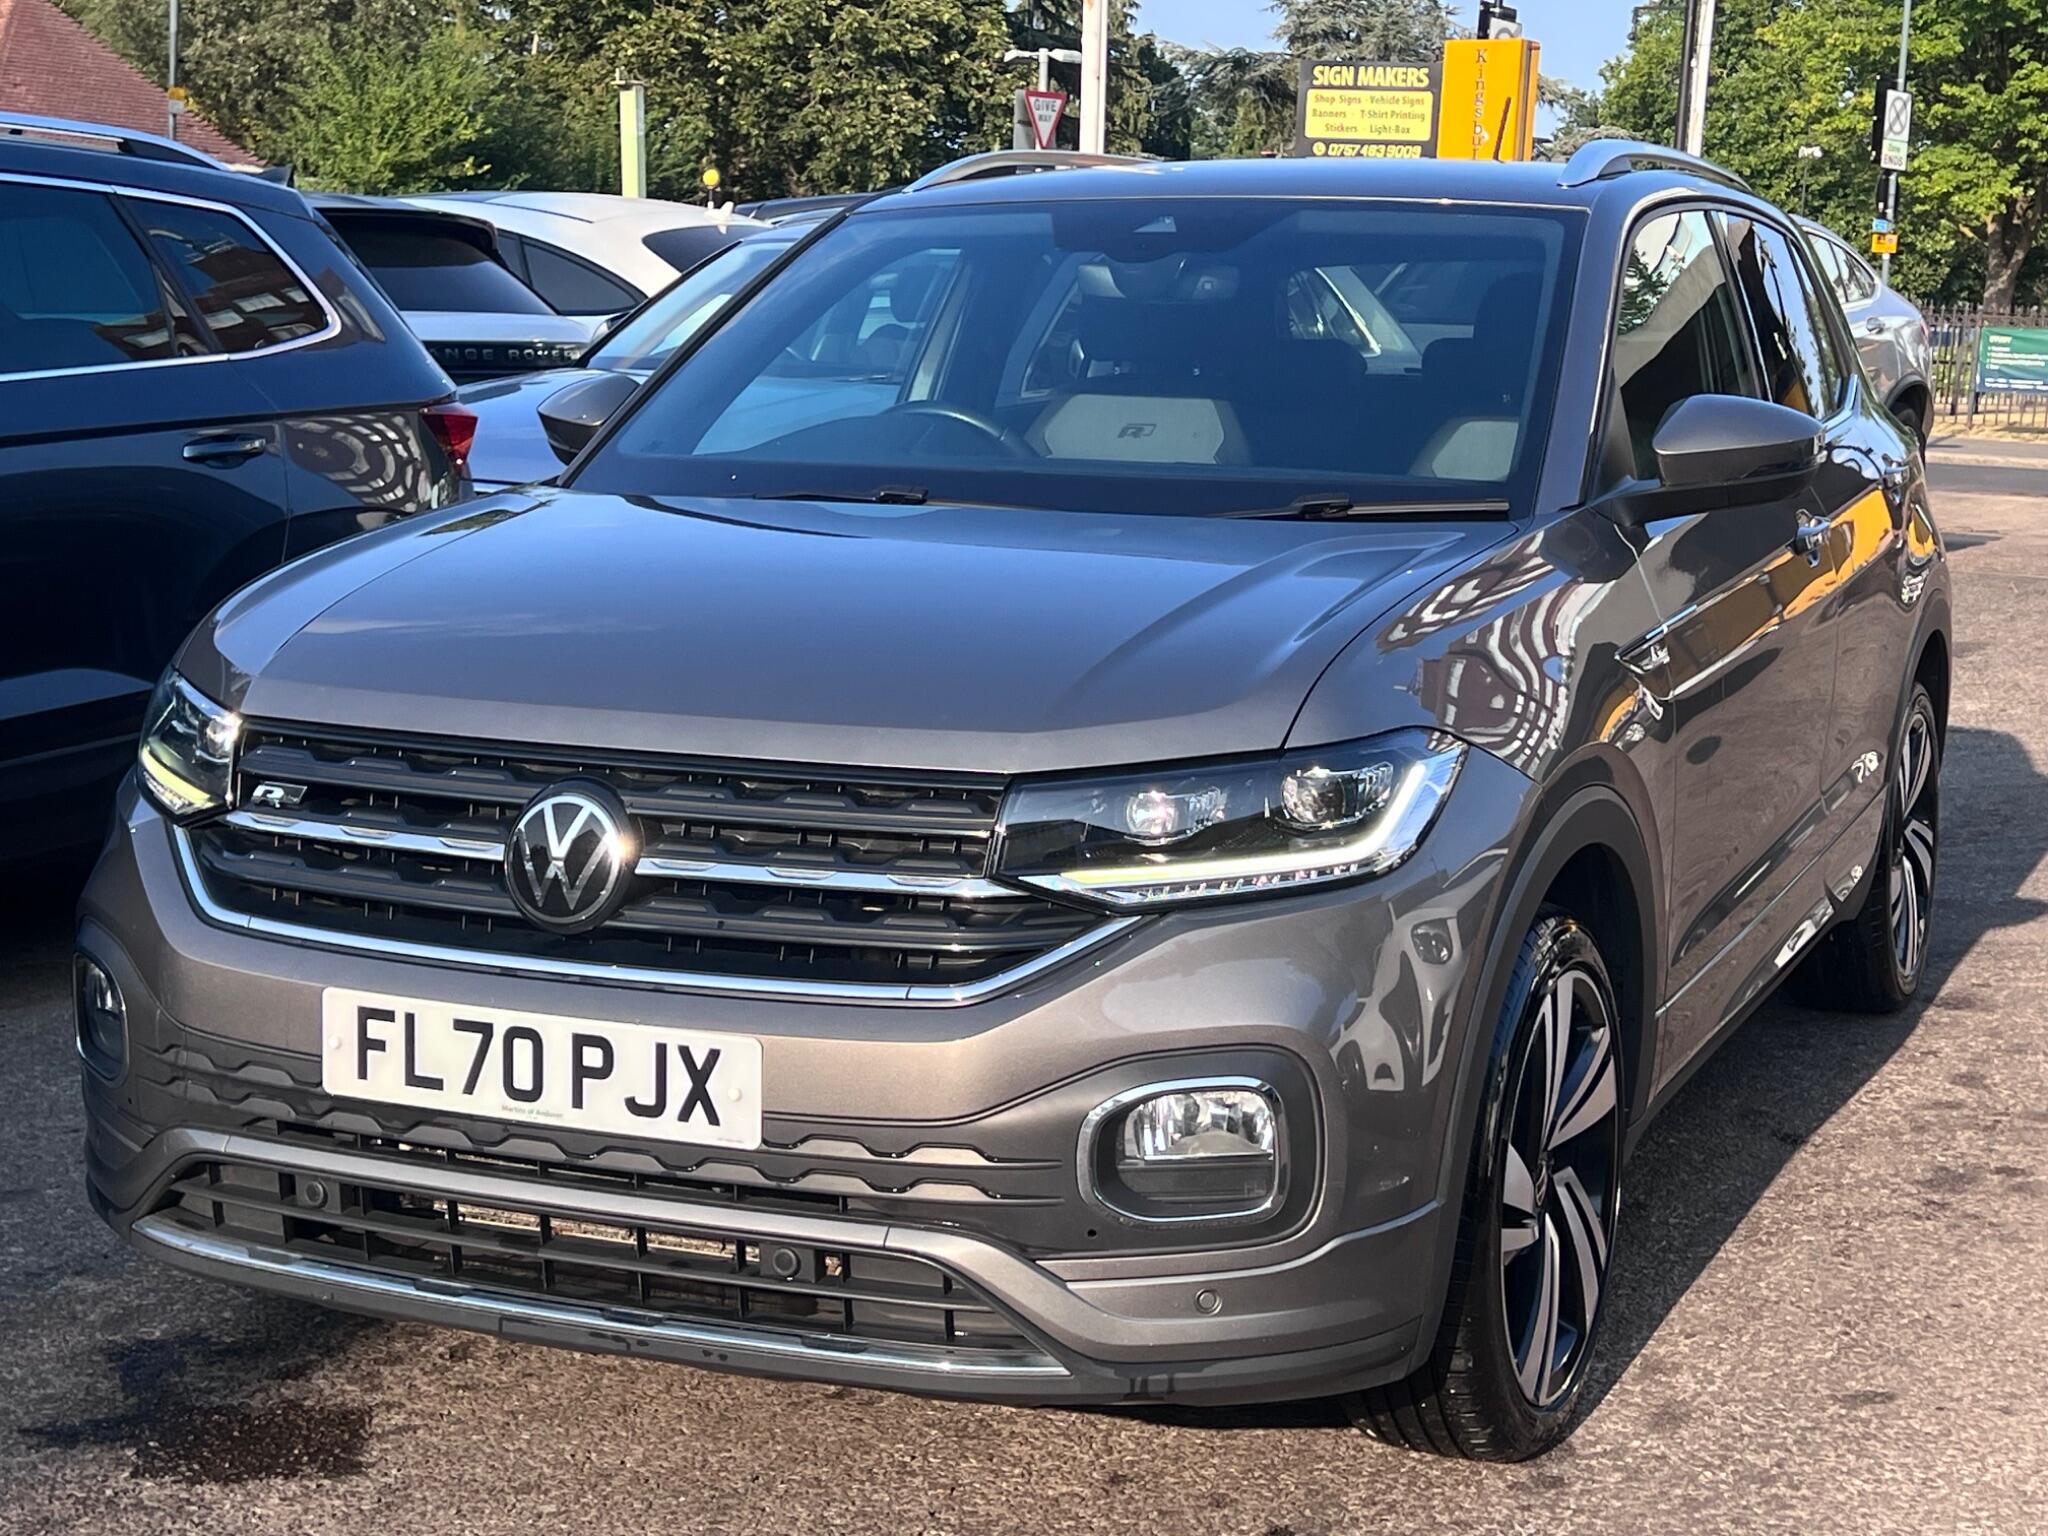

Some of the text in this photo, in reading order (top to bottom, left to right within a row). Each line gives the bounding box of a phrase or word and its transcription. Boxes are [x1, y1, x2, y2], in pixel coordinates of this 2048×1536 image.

[1313, 65, 1430, 87] SIGN MAKERS
[1034, 98, 1057, 112] GIVE
[1314, 94, 1425, 107] Shop Signs Vehicle Signs
[1473, 48, 1487, 160] Kingsbur
[1312, 108, 1425, 122] Banners T-Shirt Printing
[1325, 123, 1357, 132] Stickers
[1328, 143, 1361, 156] 0757
[1884, 154, 1904, 167] ENDS
[356, 1006, 721, 1126] FL70 PJX
